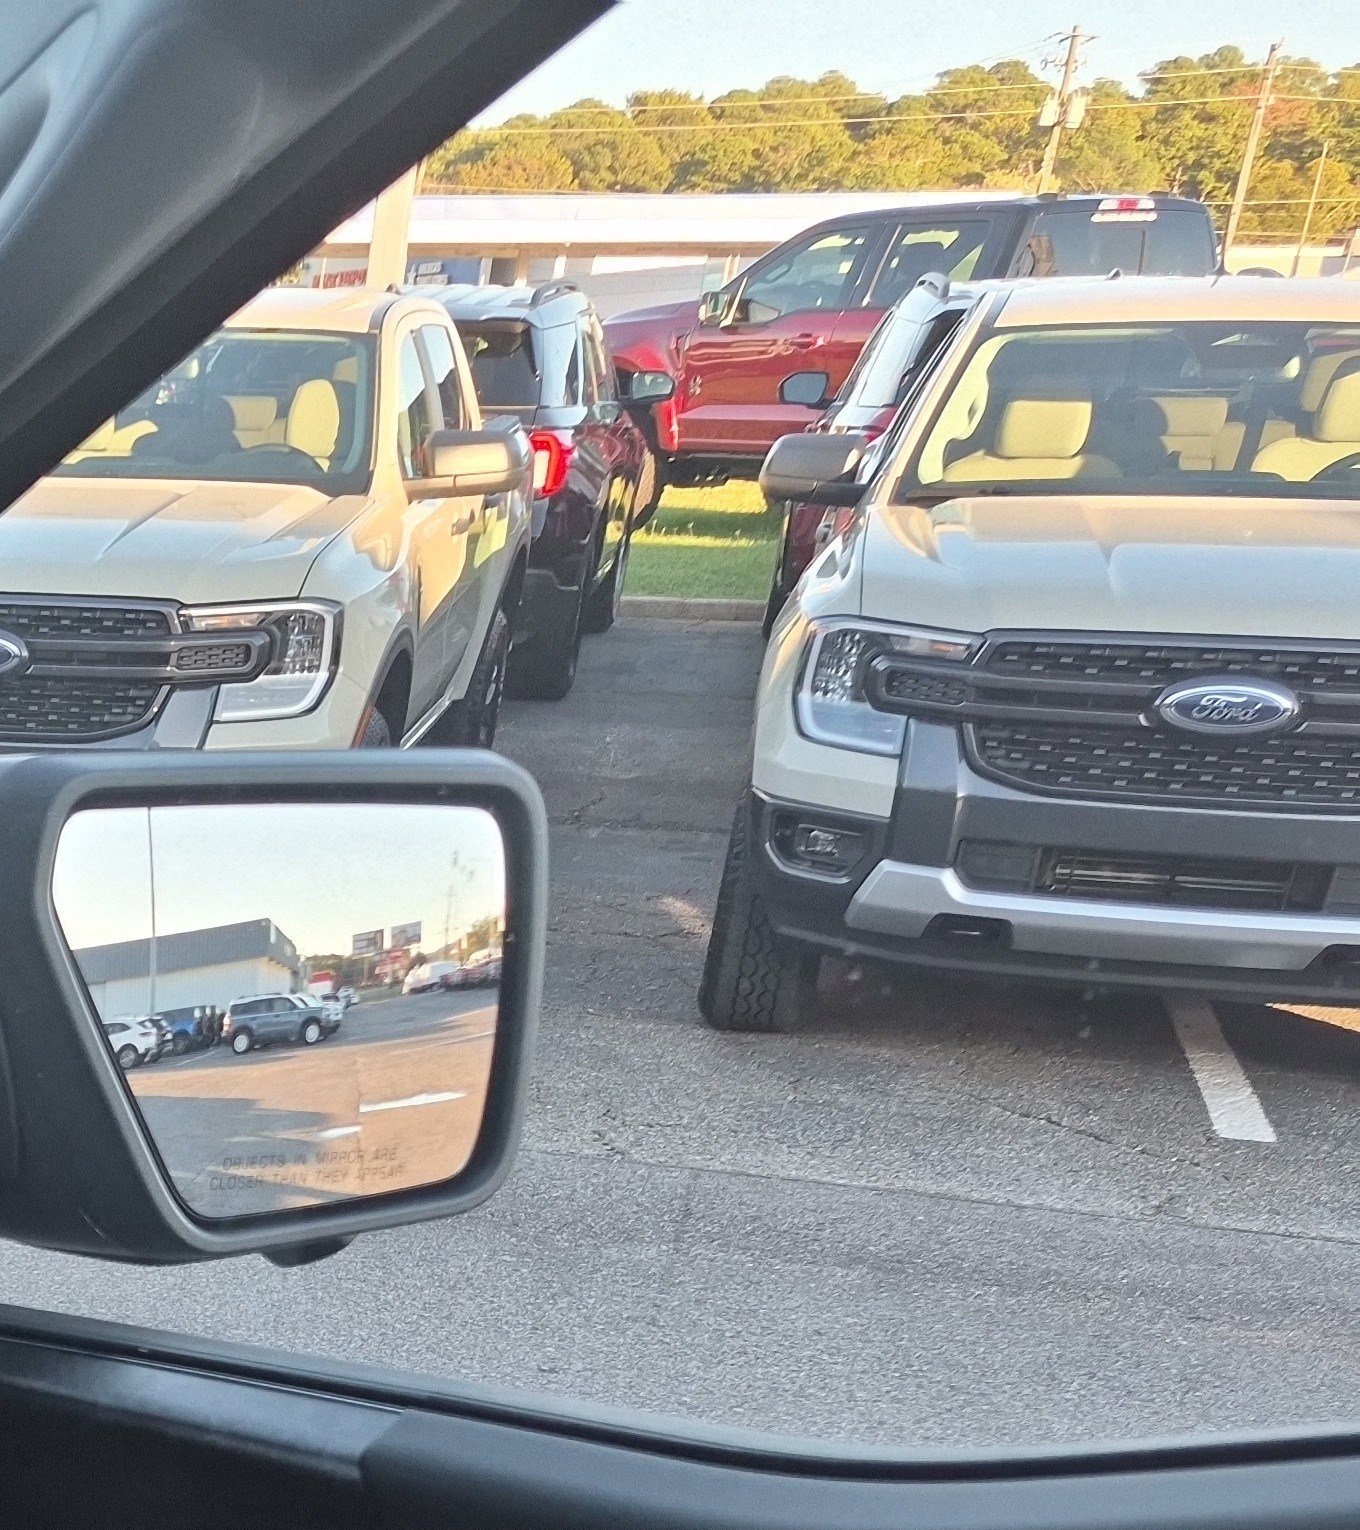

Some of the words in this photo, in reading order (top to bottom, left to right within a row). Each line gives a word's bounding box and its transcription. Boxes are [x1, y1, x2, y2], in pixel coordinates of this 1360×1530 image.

[1191, 694, 1264, 722] Ford
[223, 1155, 287, 1170] OBJECTS
[372, 1147, 398, 1161] ARE
[273, 1171, 308, 1184] THAN
[315, 1167, 348, 1183] THEY
